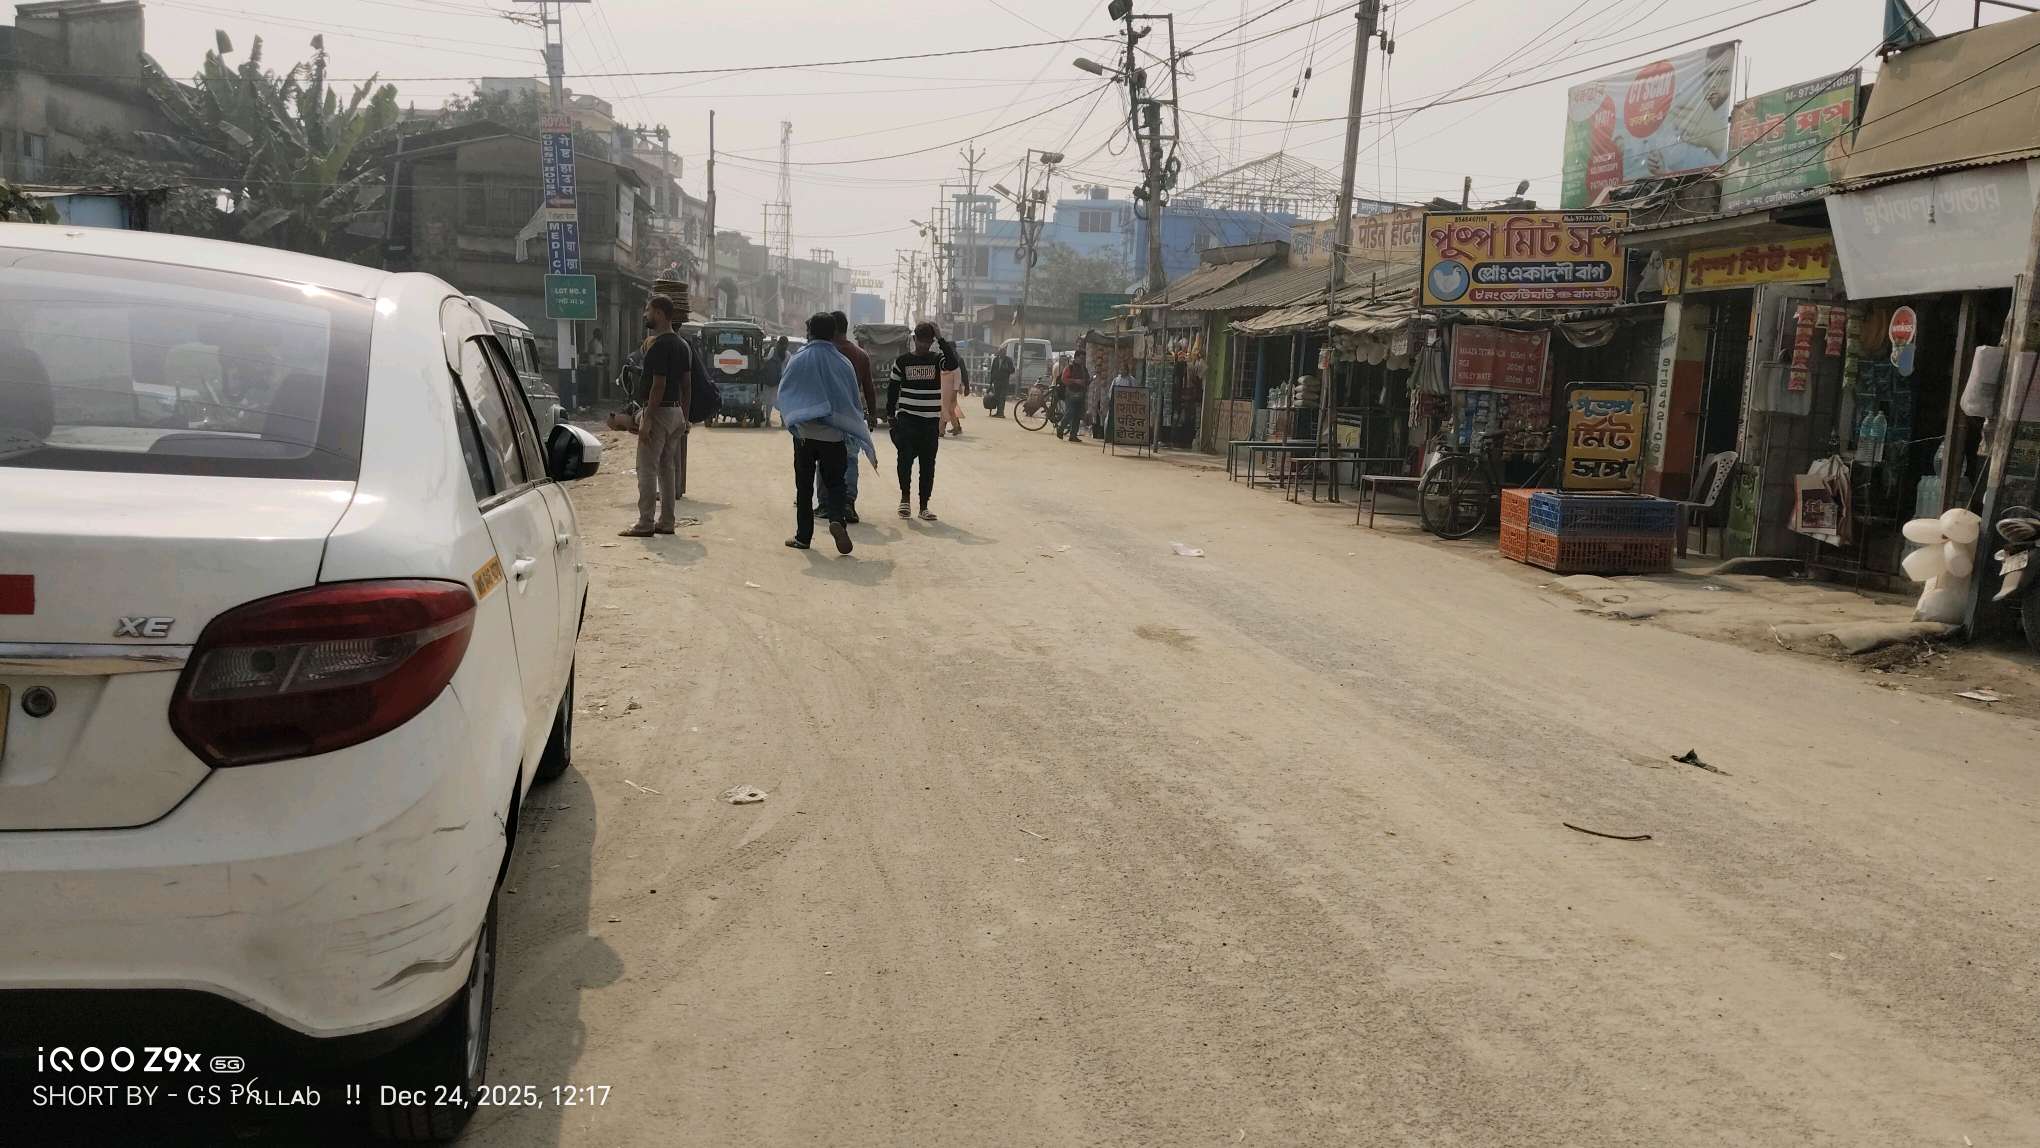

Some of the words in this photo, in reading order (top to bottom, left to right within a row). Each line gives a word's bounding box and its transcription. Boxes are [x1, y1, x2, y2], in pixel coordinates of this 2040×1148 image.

[1428, 221, 1496, 261] পুষ্প
[1503, 215, 1561, 258] মিট
[1575, 263, 1605, 281] বাগ
[112, 616, 175, 638] XE
